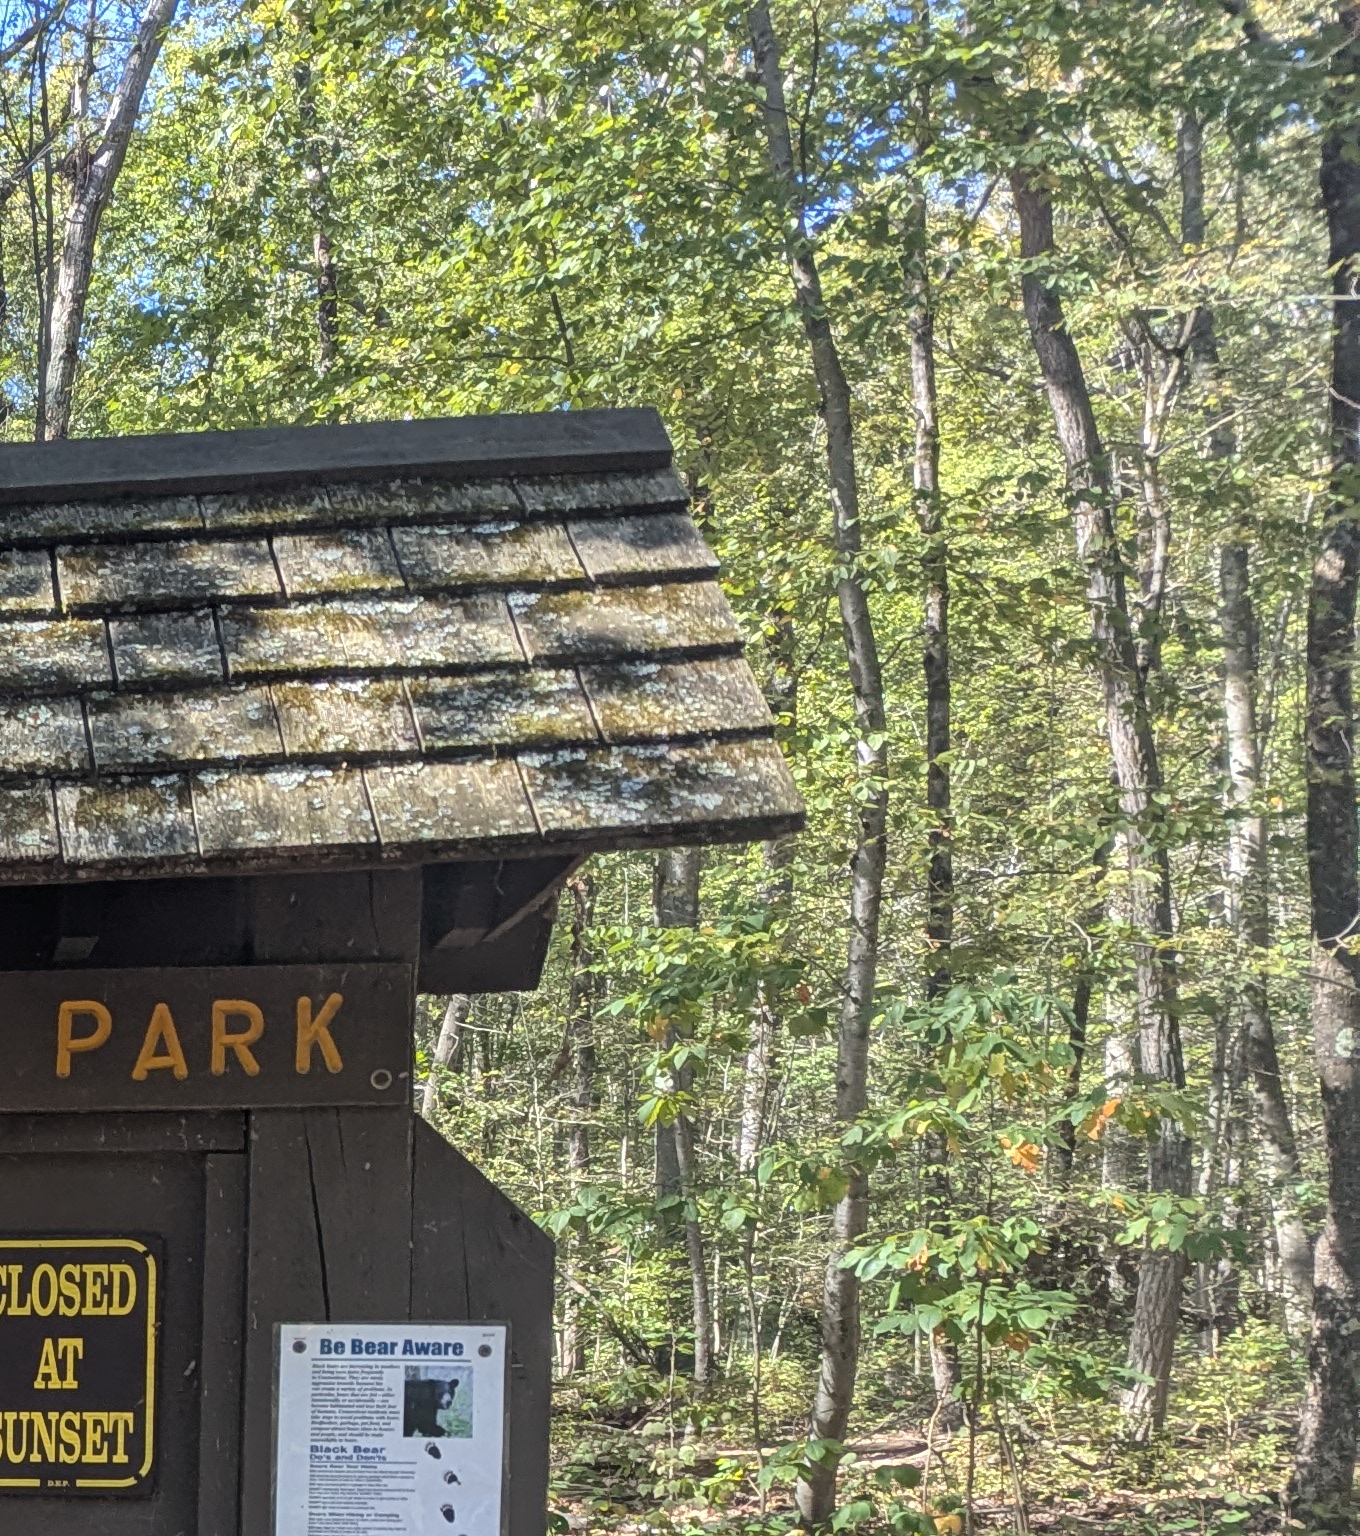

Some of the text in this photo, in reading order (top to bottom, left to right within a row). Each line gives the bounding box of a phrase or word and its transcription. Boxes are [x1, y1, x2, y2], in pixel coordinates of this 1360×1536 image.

[56, 992, 343, 1080] PARK
[320, 1339, 464, 1356] Be Bear Aware
[34, 1338, 84, 1390] AT
[310, 1445, 386, 1454] Black Bear
[47, 1479, 70, 1487] D.E.P.
